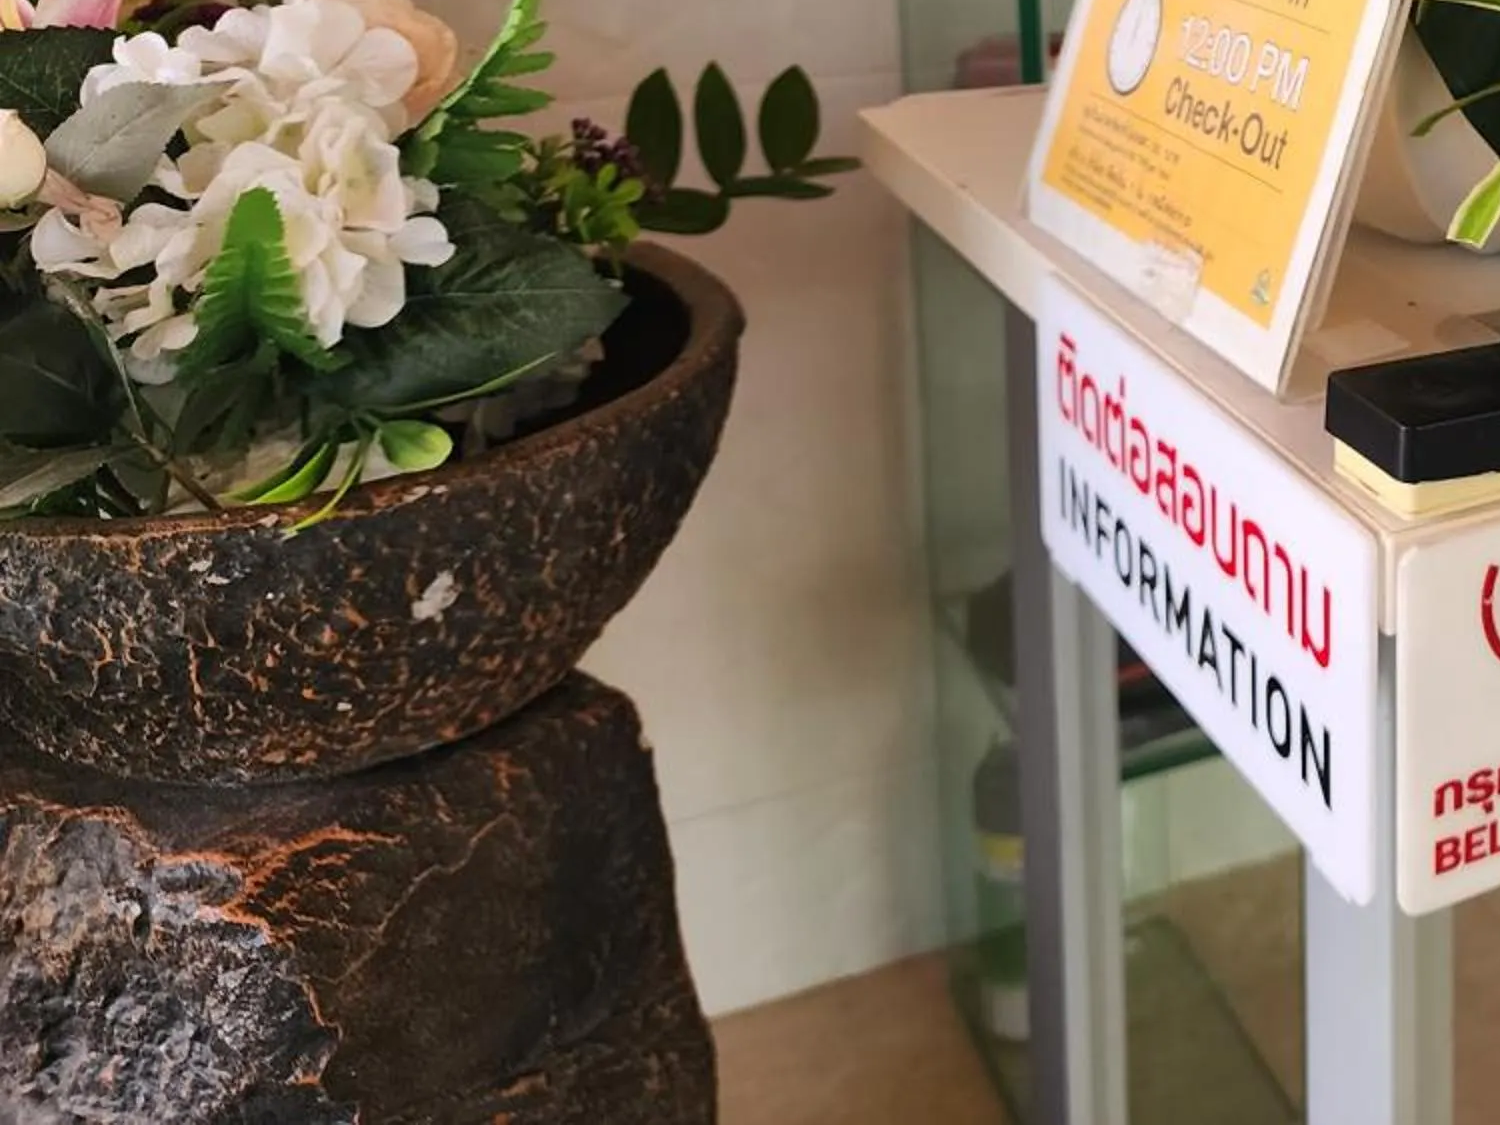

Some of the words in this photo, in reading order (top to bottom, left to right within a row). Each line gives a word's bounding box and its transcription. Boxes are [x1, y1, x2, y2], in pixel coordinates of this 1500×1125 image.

[1164, 76, 1289, 171] Check-Out
[1181, 14, 1253, 86] 12:00
[1249, 40, 1311, 112] PM
[1056, 332, 1332, 669] ติดต่อสอบถาม
[1059, 455, 1333, 812] INFORMATION
